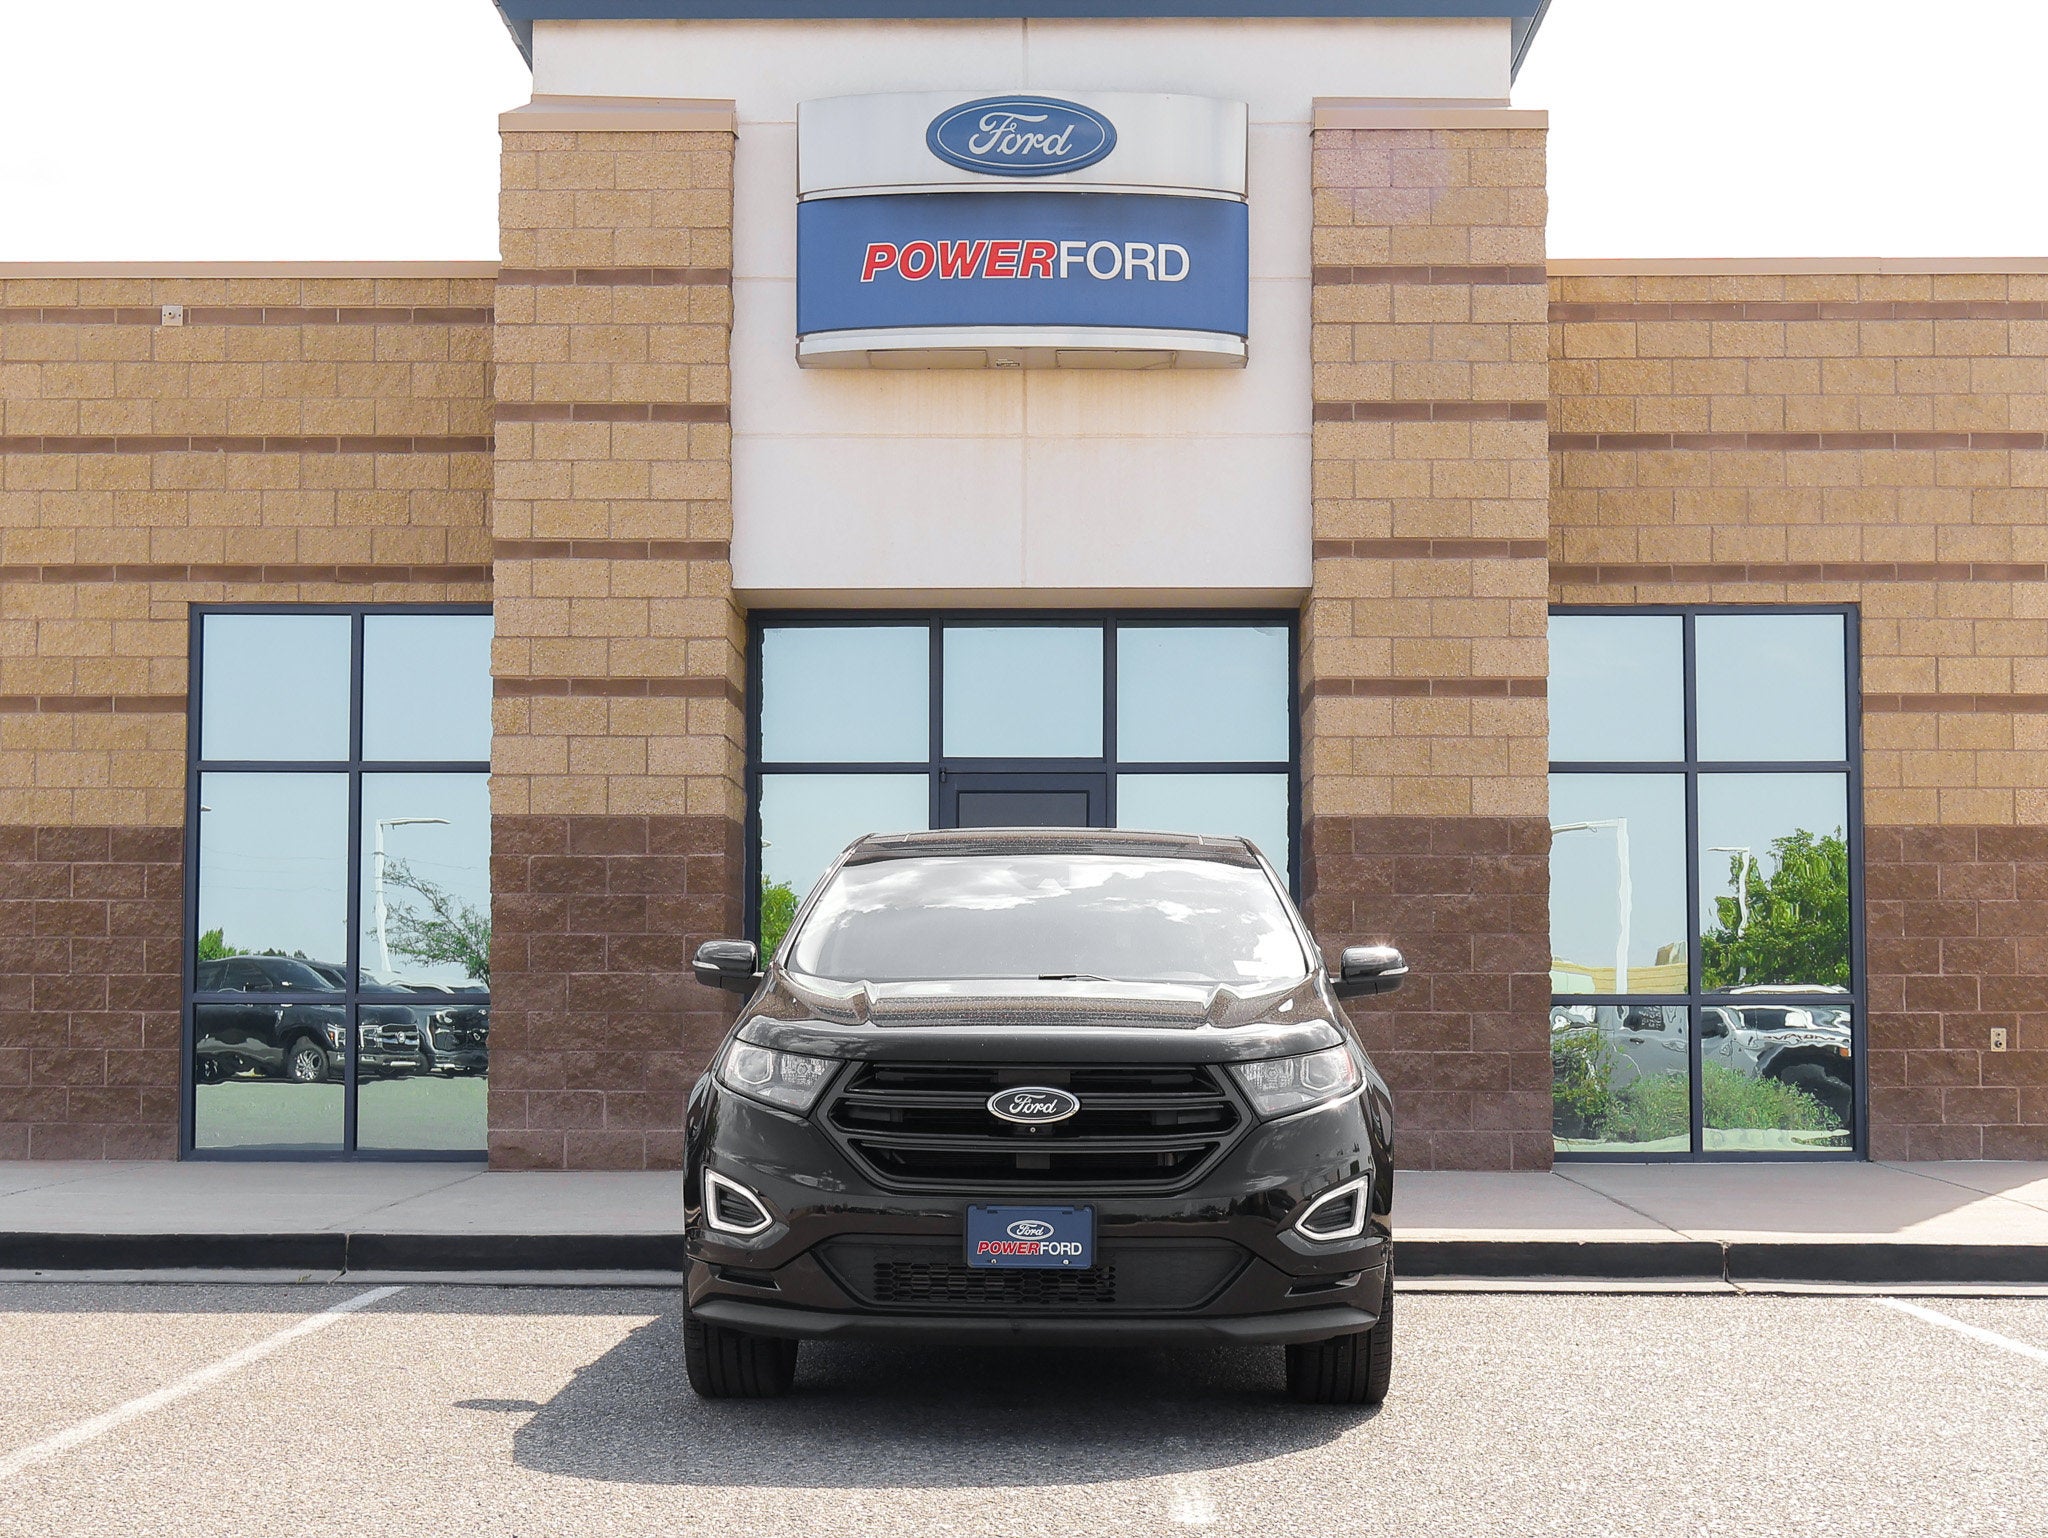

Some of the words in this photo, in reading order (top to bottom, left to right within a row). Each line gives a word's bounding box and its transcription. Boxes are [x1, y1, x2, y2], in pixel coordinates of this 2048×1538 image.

[968, 112, 1074, 156] Ford
[1009, 1093, 1057, 1114] Ford
[1016, 1224, 1044, 1236] Ford
